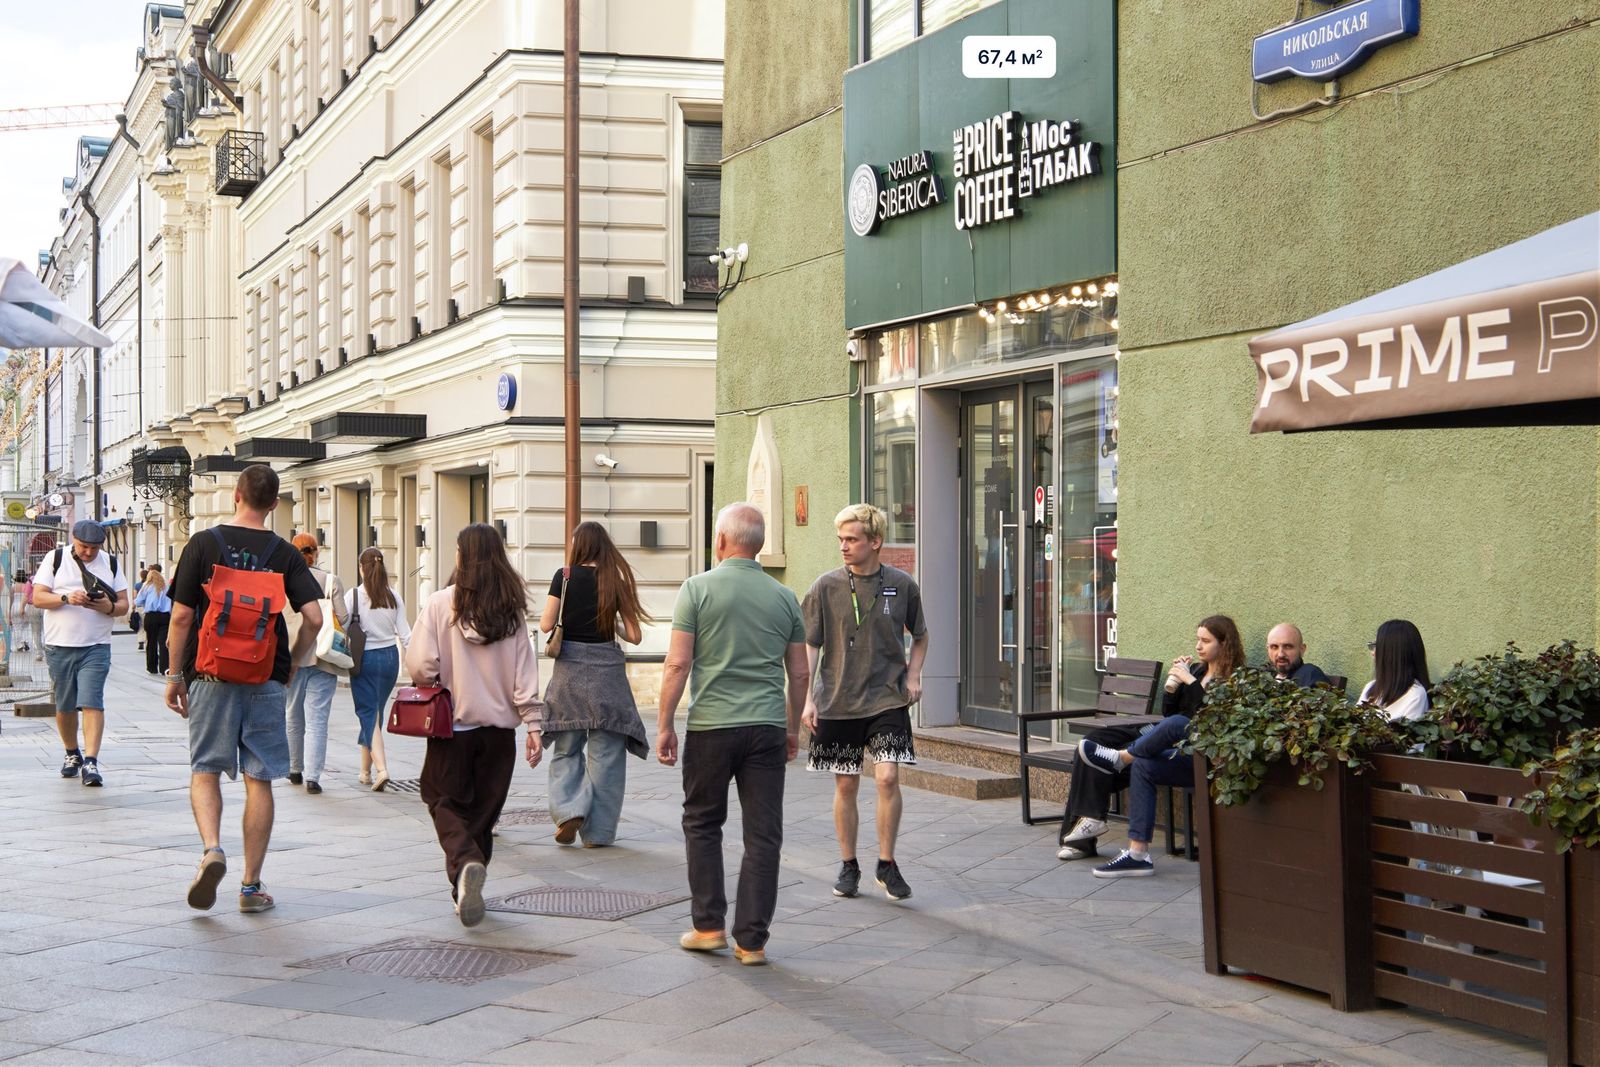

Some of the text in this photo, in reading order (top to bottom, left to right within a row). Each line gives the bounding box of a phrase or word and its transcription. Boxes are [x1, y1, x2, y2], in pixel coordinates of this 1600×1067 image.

[1283, 11, 1368, 57] НИКОЛЬСКАЯ
[1310, 52, 1340, 70] УЛИЦА
[953, 128, 963, 178] ONE
[964, 110, 1013, 176] PRICE
[1032, 119, 1071, 154] Мос
[888, 149, 928, 181] NATURA
[1032, 141, 1092, 189] ТАБАК
[879, 174, 939, 220] SIBERICA
[954, 165, 1014, 231] COFFEE
[1260, 308, 1516, 409] PRIME
